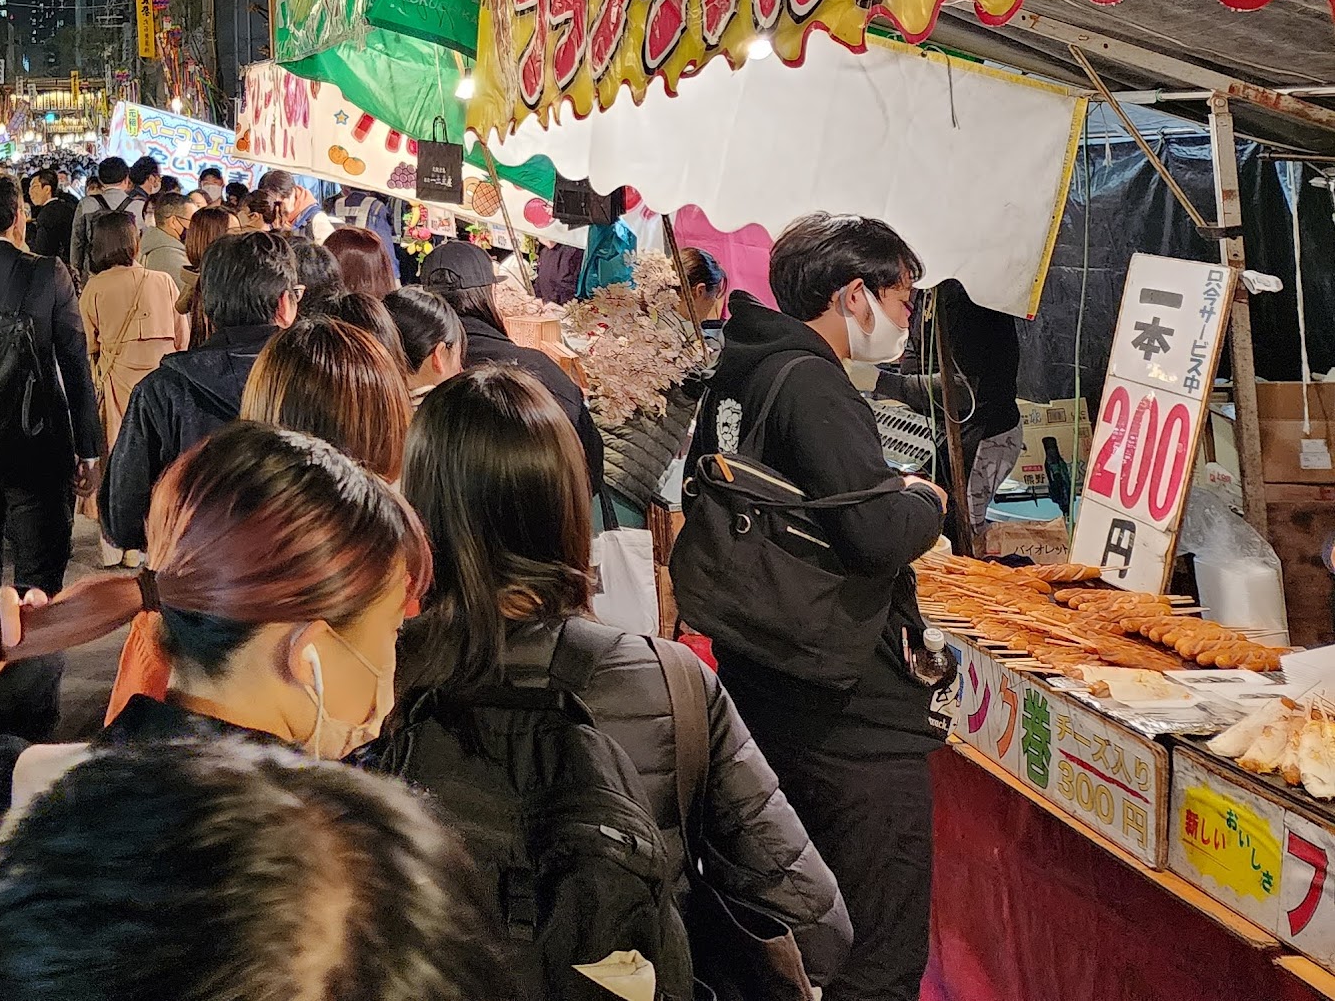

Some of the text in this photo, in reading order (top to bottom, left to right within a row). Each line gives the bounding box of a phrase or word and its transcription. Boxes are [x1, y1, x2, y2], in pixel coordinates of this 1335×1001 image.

[1131, 287, 1184, 362] 一本
[1184, 269, 1224, 395] 只今サービス中
[1087, 385, 1191, 522] 200
[1100, 517, 1137, 579] 円
[1055, 714, 1153, 792] チーズ入り
[1057, 759, 1149, 851] 300円
[1185, 808, 1227, 851] 新しい
[1224, 807, 1275, 894] おいしさ
